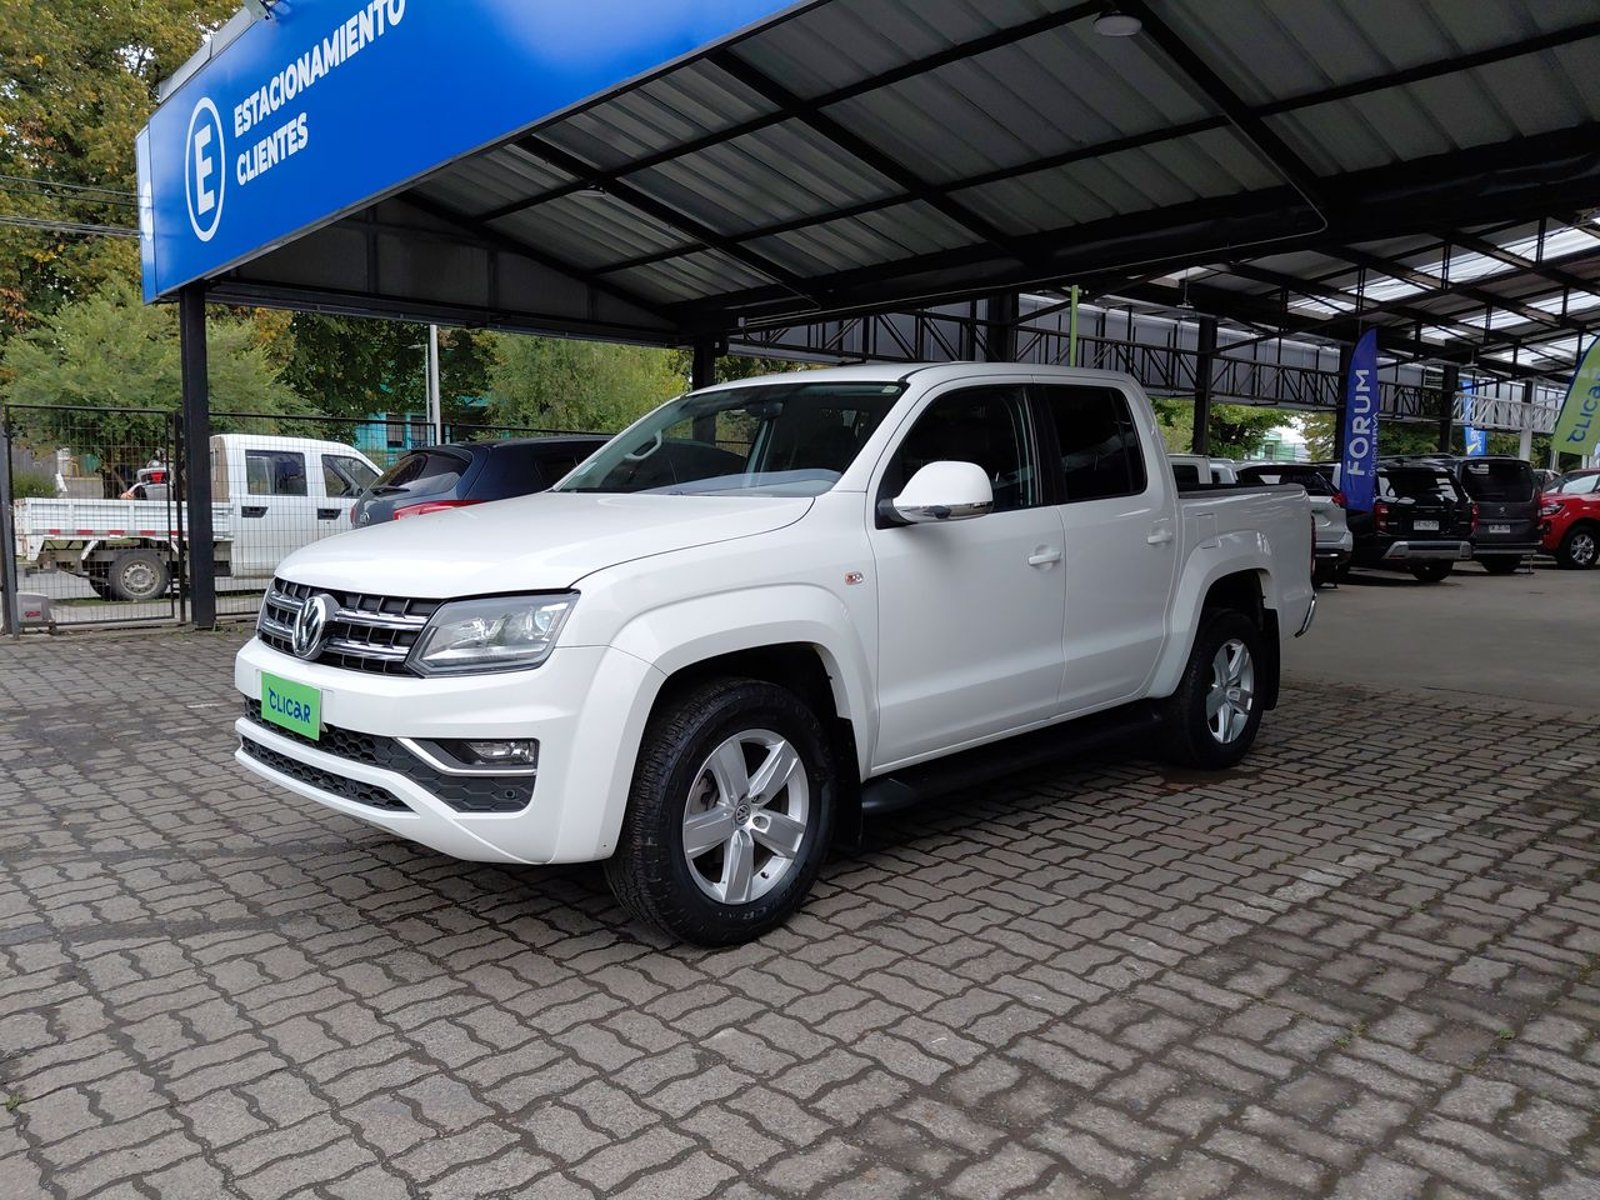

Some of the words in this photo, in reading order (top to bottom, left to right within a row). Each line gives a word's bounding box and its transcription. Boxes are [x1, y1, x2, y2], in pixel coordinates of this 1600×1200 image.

[234, 0, 406, 138] ESTACIONAMIENTO
[194, 125, 216, 216] E
[236, 112, 309, 186] CLIENTES
[1347, 369, 1371, 476] FORUM
